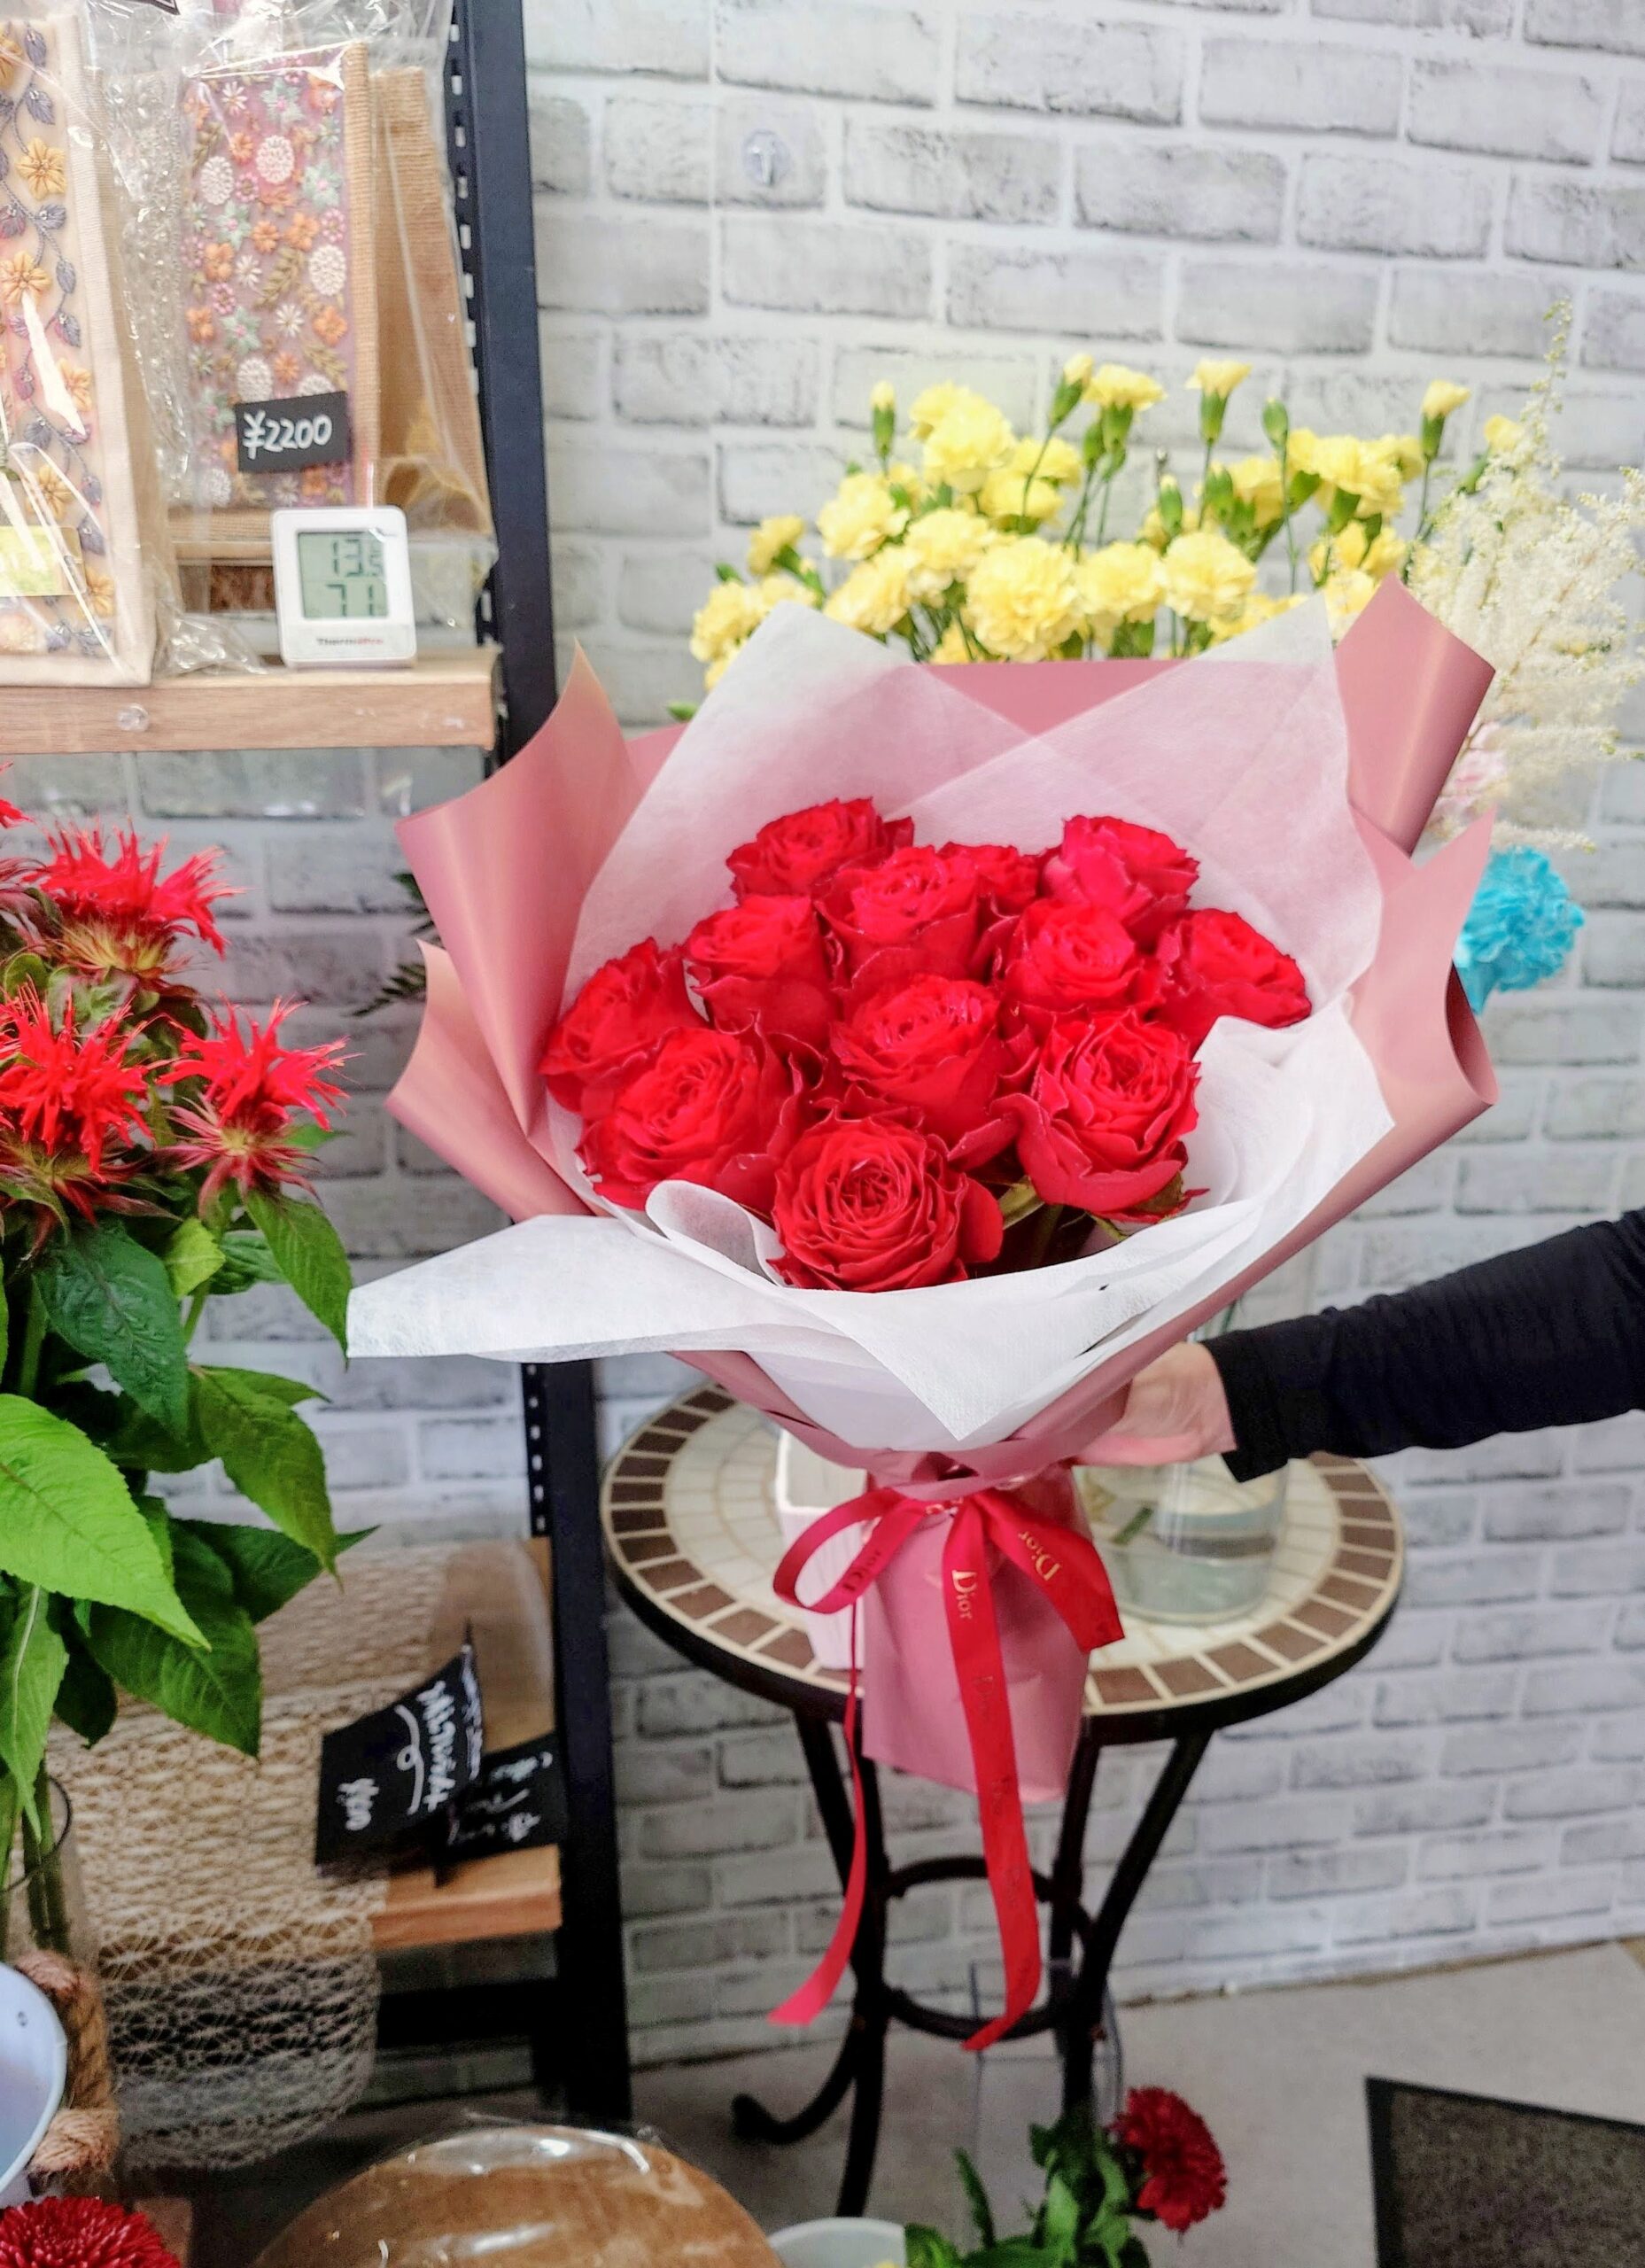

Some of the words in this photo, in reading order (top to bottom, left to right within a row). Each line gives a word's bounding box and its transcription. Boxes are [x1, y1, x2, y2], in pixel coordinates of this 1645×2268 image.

[243, 410, 333, 460] ¥2200
[325, 583, 374, 617] 71
[1016, 1531, 1061, 1581] Dior
[951, 1569, 977, 1619] Dior
